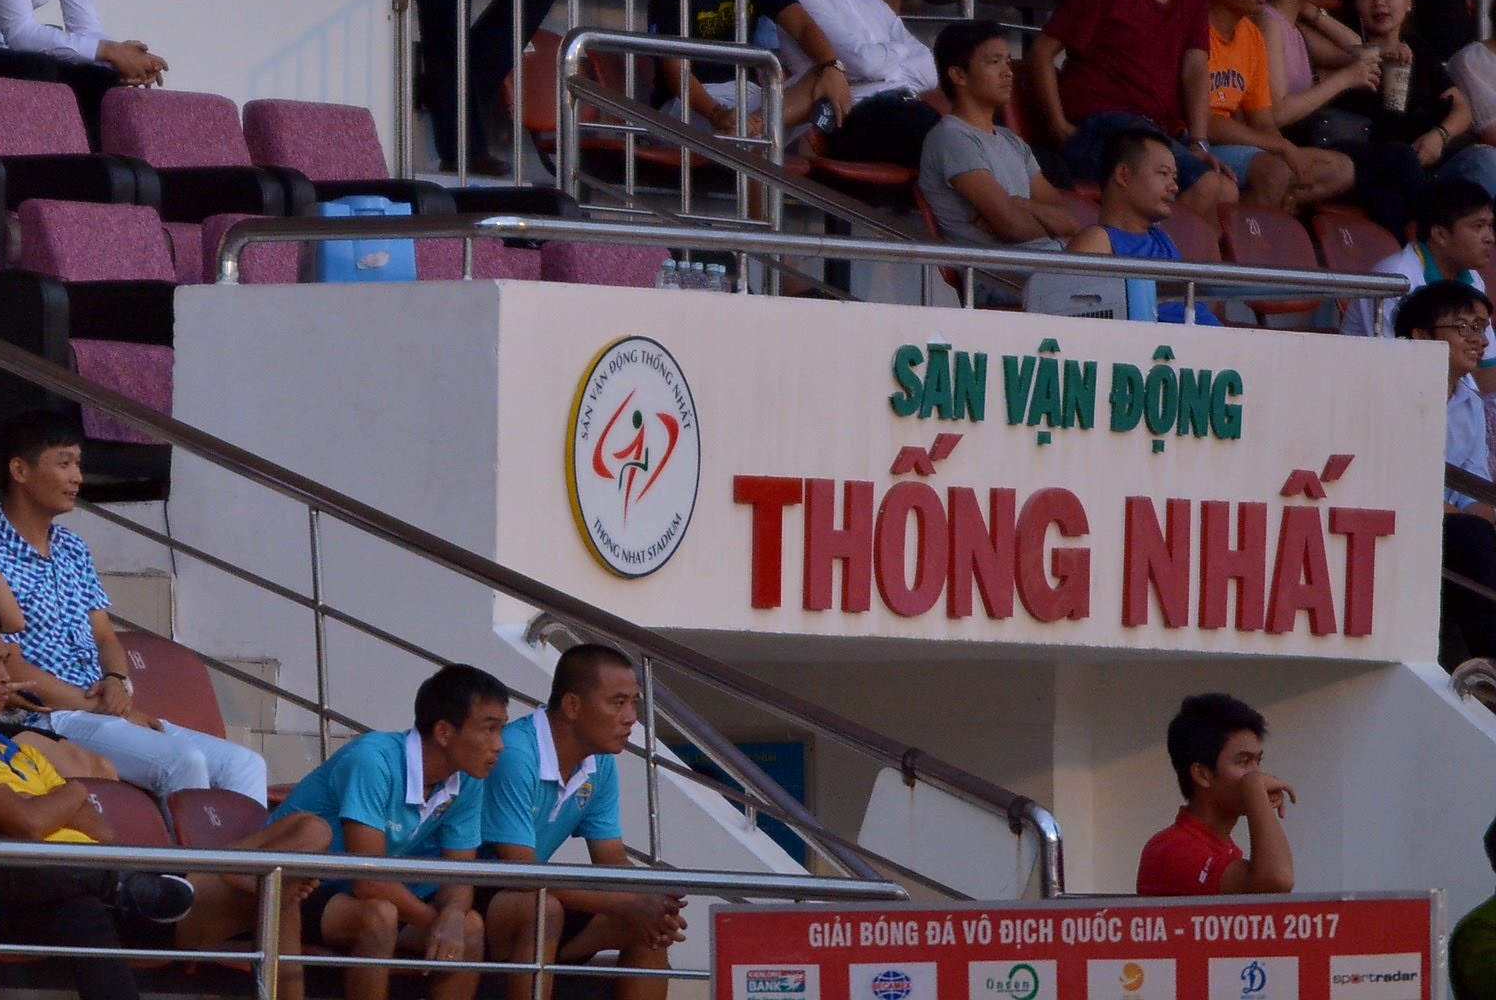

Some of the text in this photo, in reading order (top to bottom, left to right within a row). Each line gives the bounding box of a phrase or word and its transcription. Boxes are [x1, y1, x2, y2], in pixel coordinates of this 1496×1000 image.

[590, 373, 609, 397] VẬN
[608, 349, 638, 375] ĐỘNG
[641, 350, 673, 386] THỐNG
[671, 385, 692, 430] NHẤT
[888, 332, 1243, 454] SÂN VẬN ĐỘNG
[593, 512, 682, 564] THONG NHAT STADIUM
[733, 433, 1396, 637] THỐNG NHẤT
[809, 915, 852, 947] GIẢI
[859, 916, 919, 947] BÓNG
[925, 915, 956, 946] ĐÁ
[962, 914, 993, 946] VÔ
[999, 918, 1054, 950] ĐỊCH
[1061, 909, 1122, 946] QUỐC
[1130, 917, 1168, 942] GIA
[1191, 914, 1277, 942] TOYOTA
[1283, 913, 1340, 939] 2017
[748, 981, 781, 992] BANK
[1333, 971, 1418, 985] sportradar
